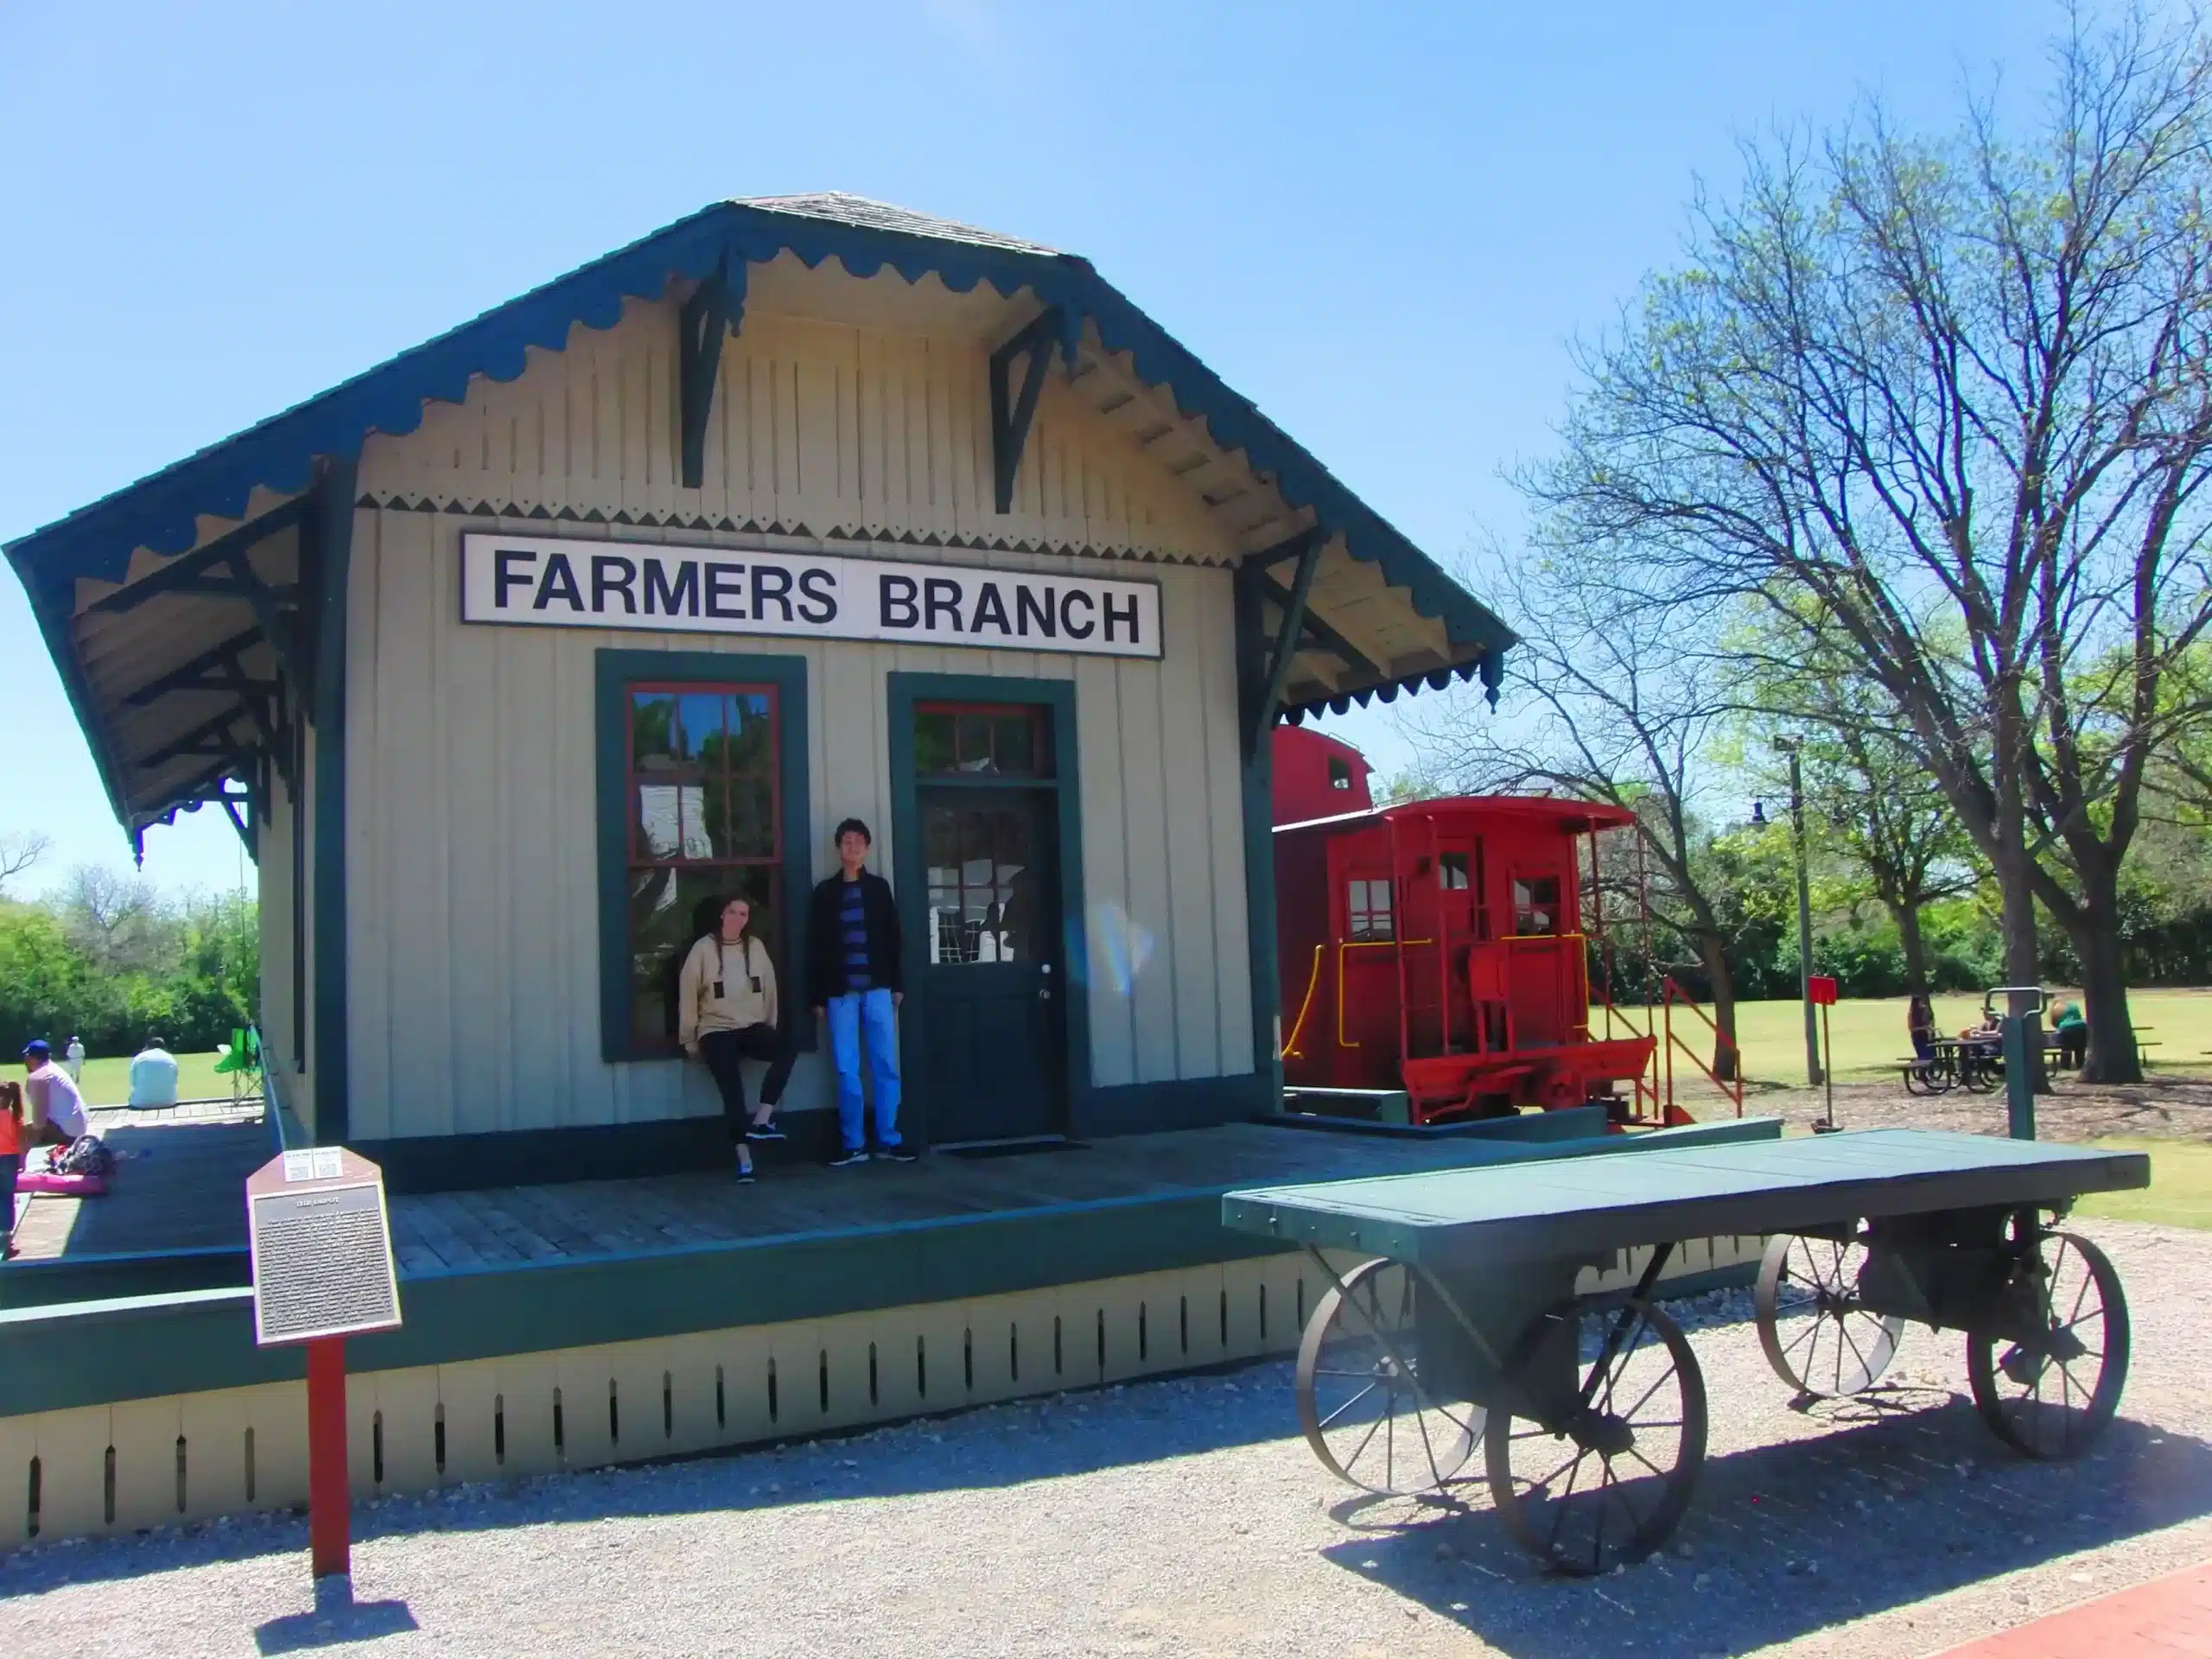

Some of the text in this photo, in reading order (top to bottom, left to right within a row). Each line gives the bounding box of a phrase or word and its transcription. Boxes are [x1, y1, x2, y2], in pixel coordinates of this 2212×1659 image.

[494, 550, 1140, 644] FARMERS BRANCH
[314, 1196, 340, 1206] DEPOT
